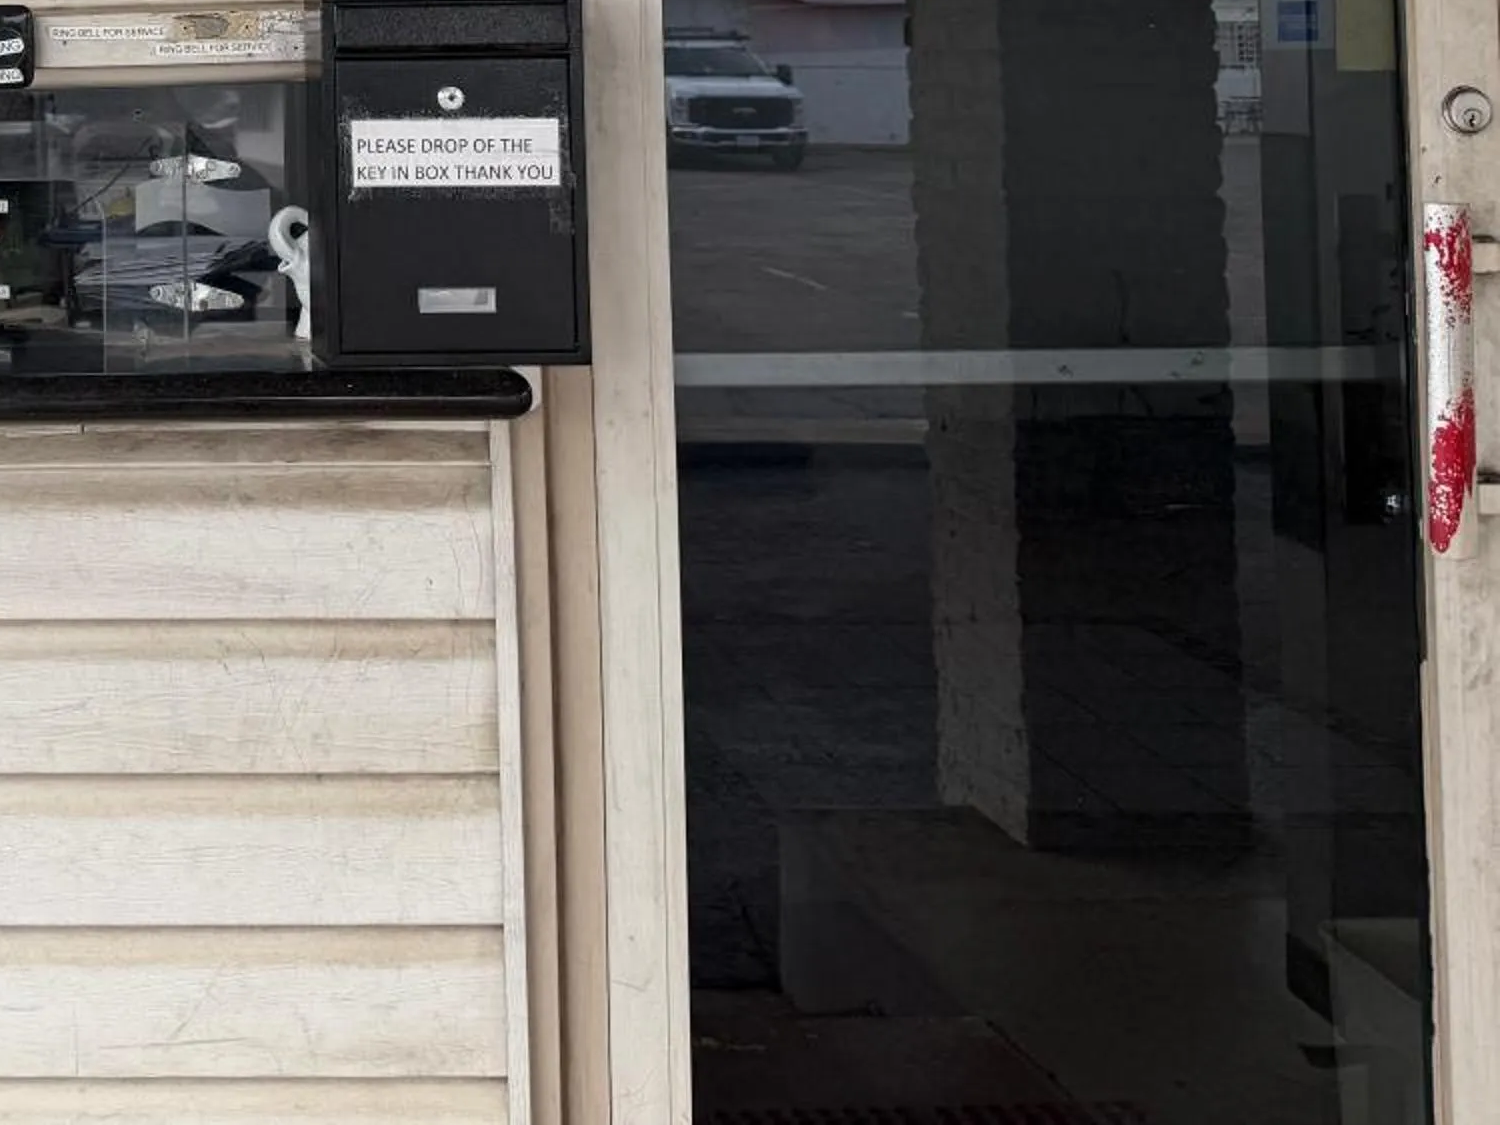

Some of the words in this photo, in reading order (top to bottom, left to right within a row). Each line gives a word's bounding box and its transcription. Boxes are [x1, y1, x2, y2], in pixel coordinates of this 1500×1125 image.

[356, 138, 416, 154] PLEASE
[420, 138, 469, 154] DROP
[473, 138, 497, 154] OF
[499, 138, 534, 153] THE
[356, 165, 388, 180] KEY
[391, 165, 409, 180] IN
[415, 165, 450, 180] BOX
[454, 164, 513, 180] THANK
[517, 164, 554, 180] YOU
